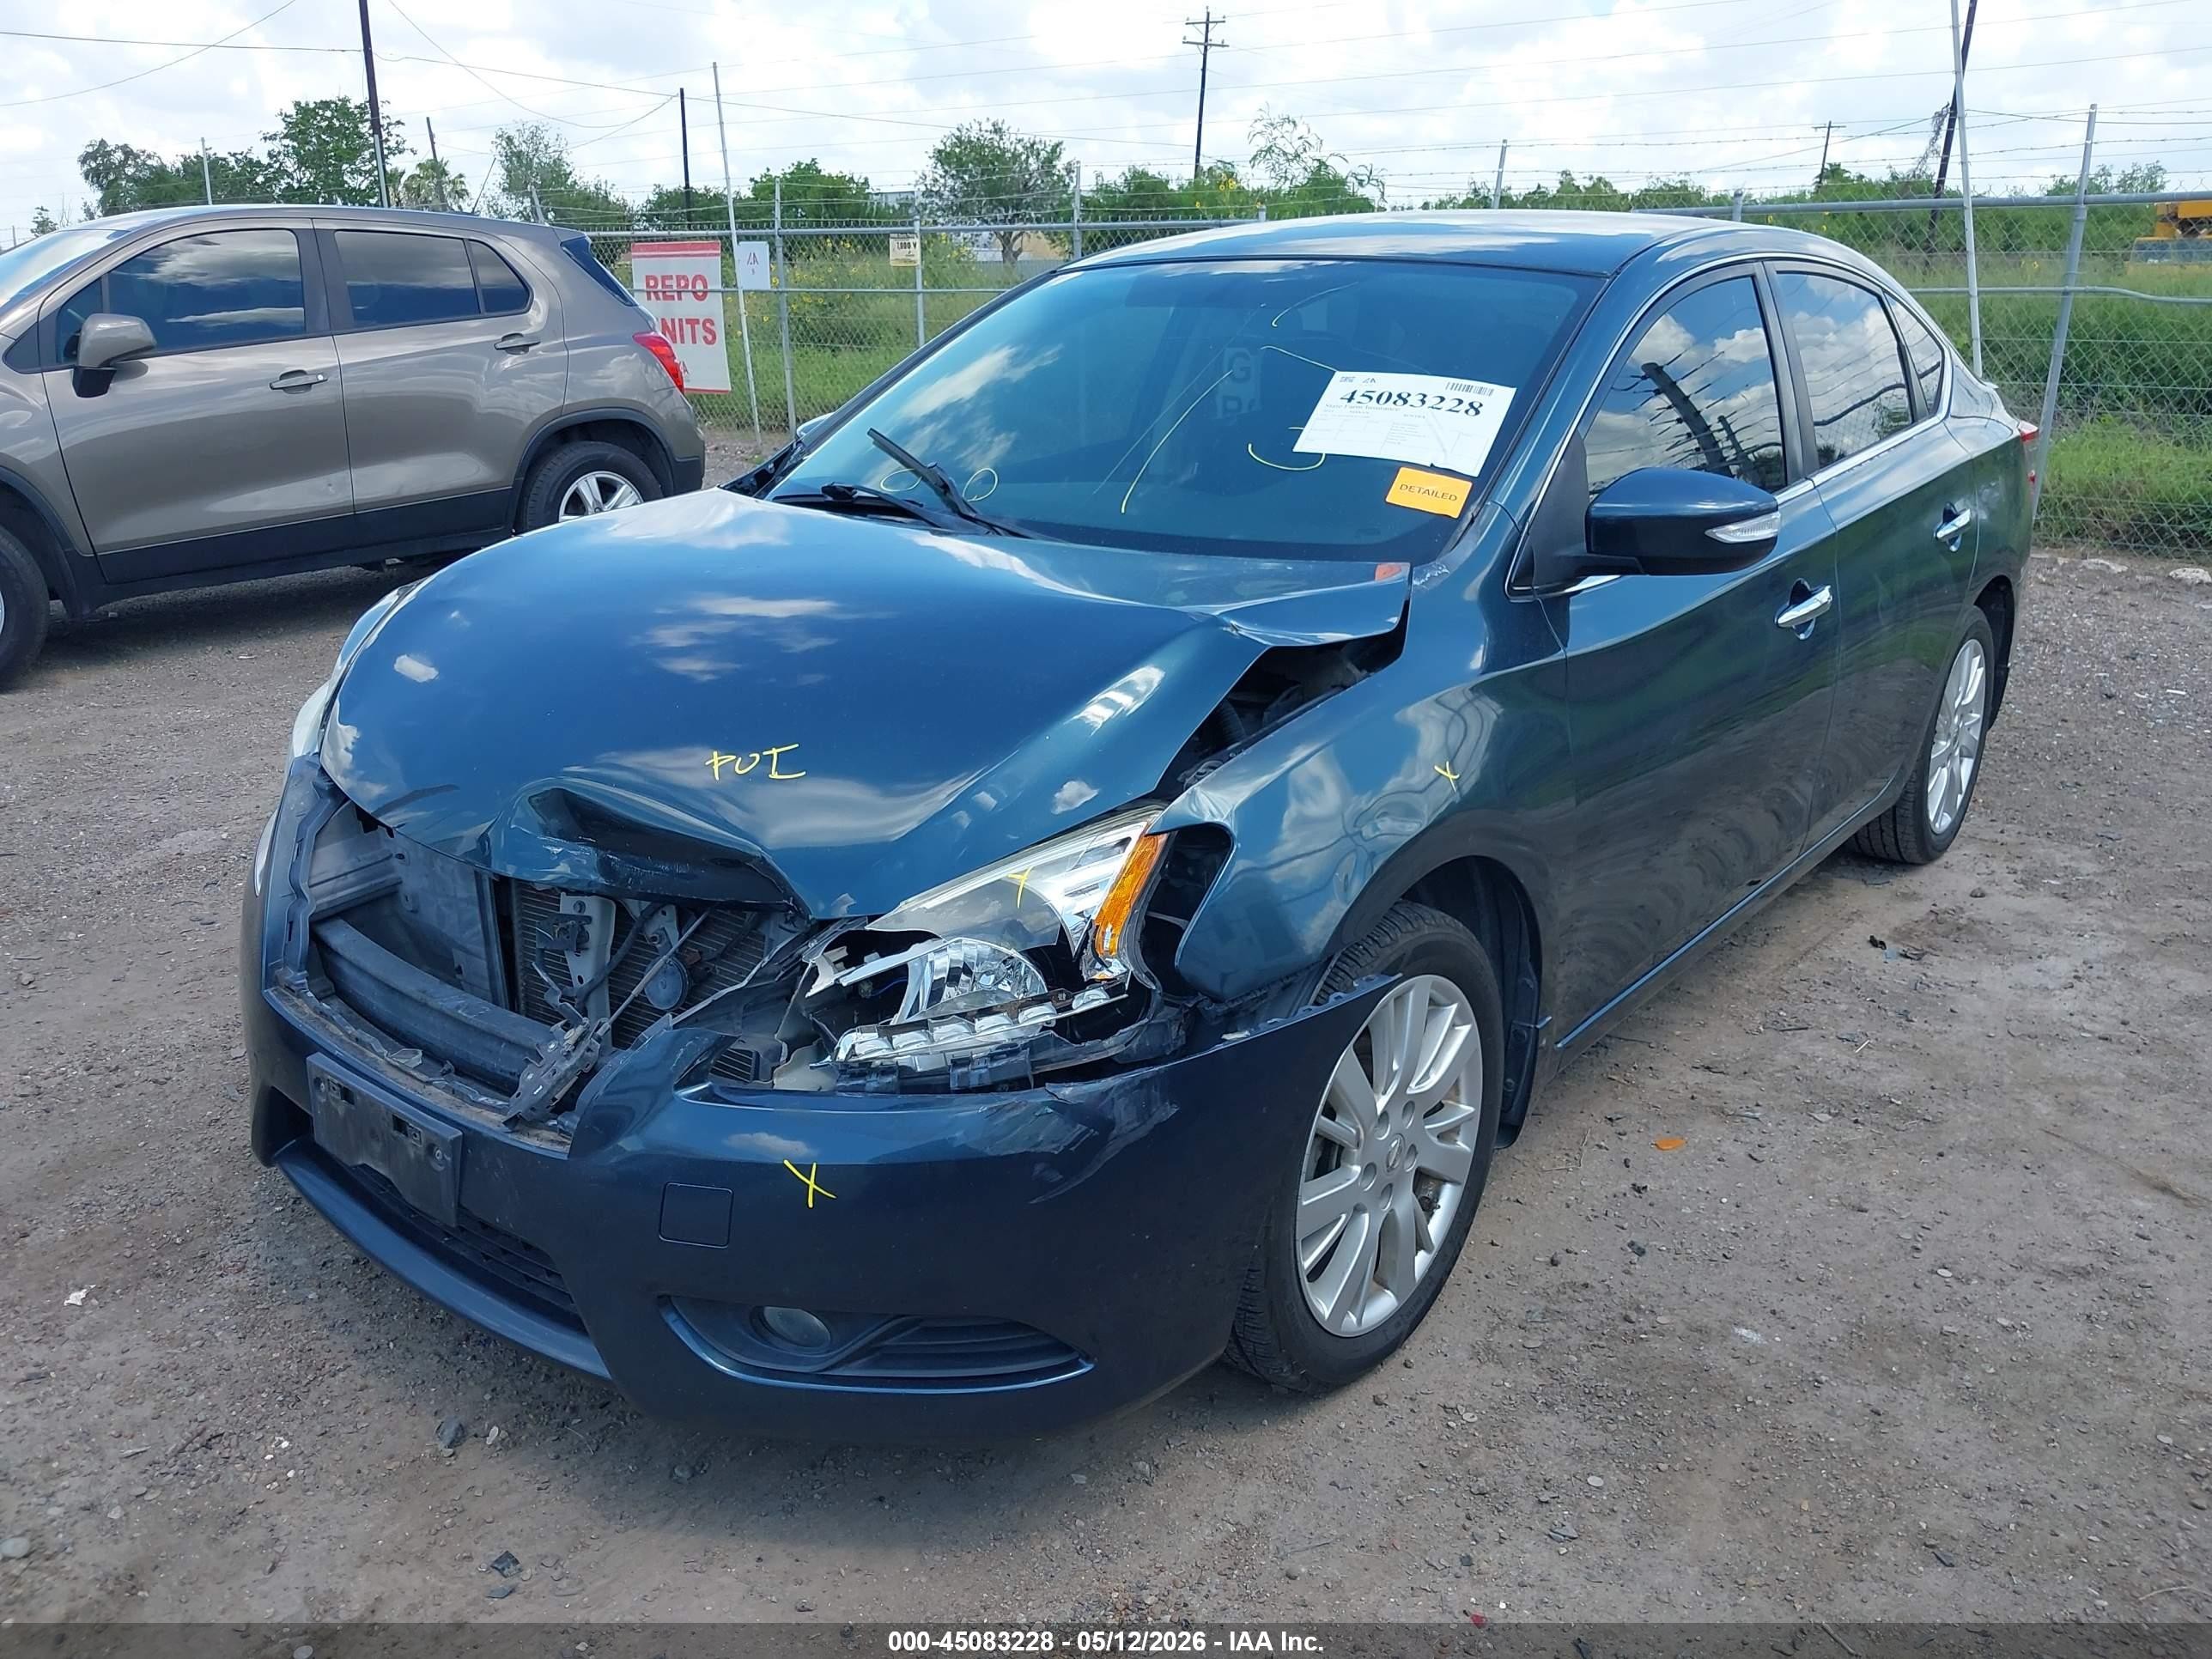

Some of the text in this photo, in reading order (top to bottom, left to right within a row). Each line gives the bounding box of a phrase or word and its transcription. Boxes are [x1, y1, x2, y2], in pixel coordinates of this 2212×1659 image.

[645, 274, 708, 302] REPO
[657, 318, 717, 345] NITS
[1339, 388, 1484, 417] 45083228
[1399, 483, 1457, 501] DETAILED
